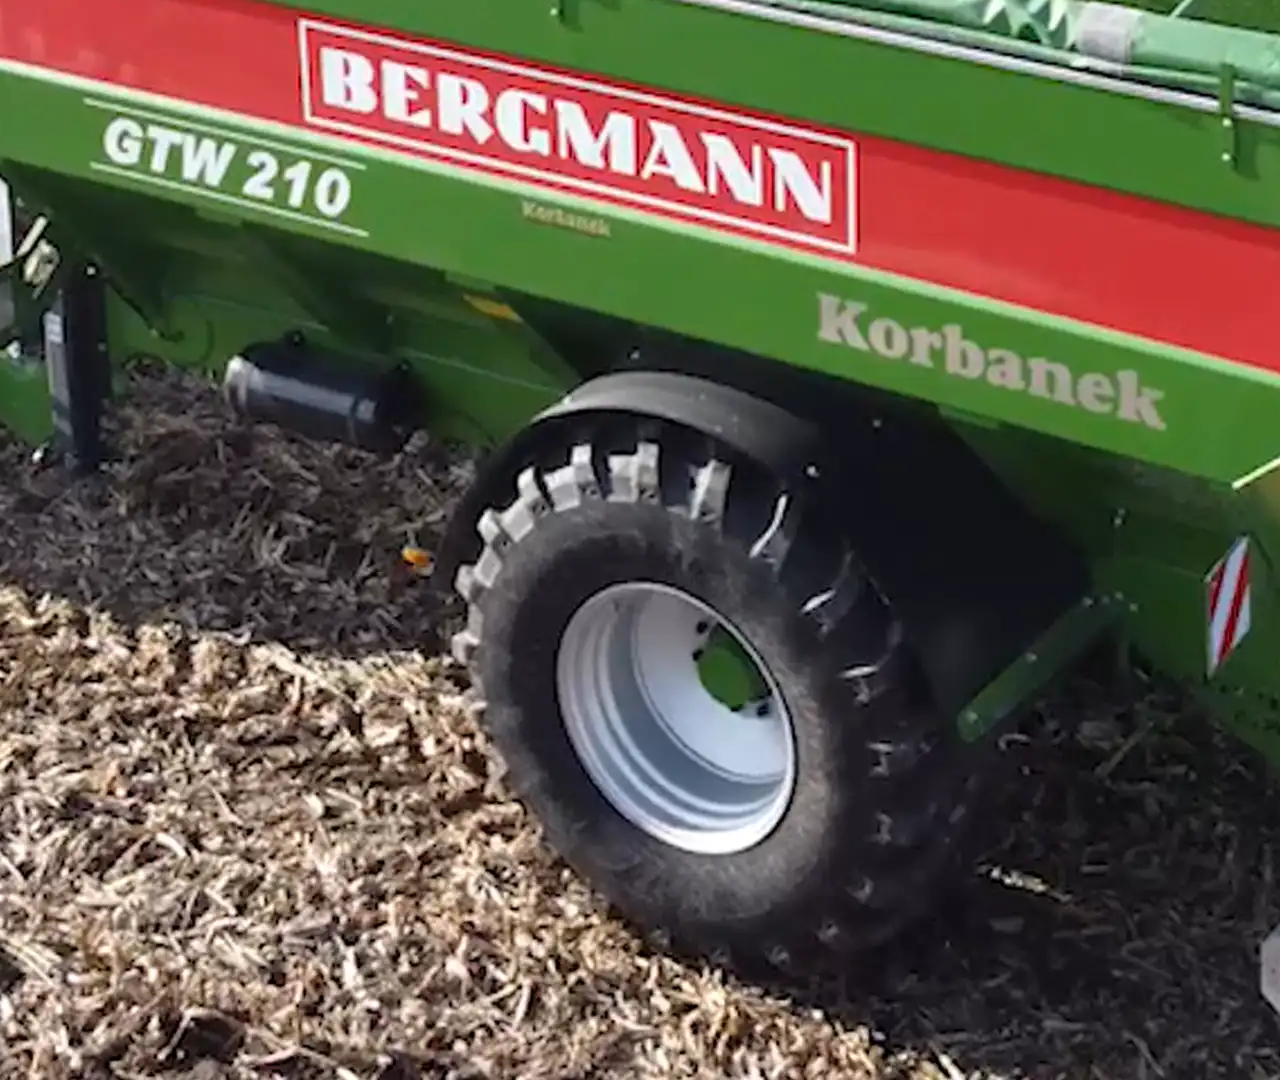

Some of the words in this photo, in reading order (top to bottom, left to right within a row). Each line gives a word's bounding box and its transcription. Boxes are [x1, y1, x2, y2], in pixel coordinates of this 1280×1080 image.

[102, 117, 238, 188] GTW
[242, 152, 352, 218] 210
[320, 45, 832, 224] BERGMANN
[816, 291, 1167, 432] Korbanek
